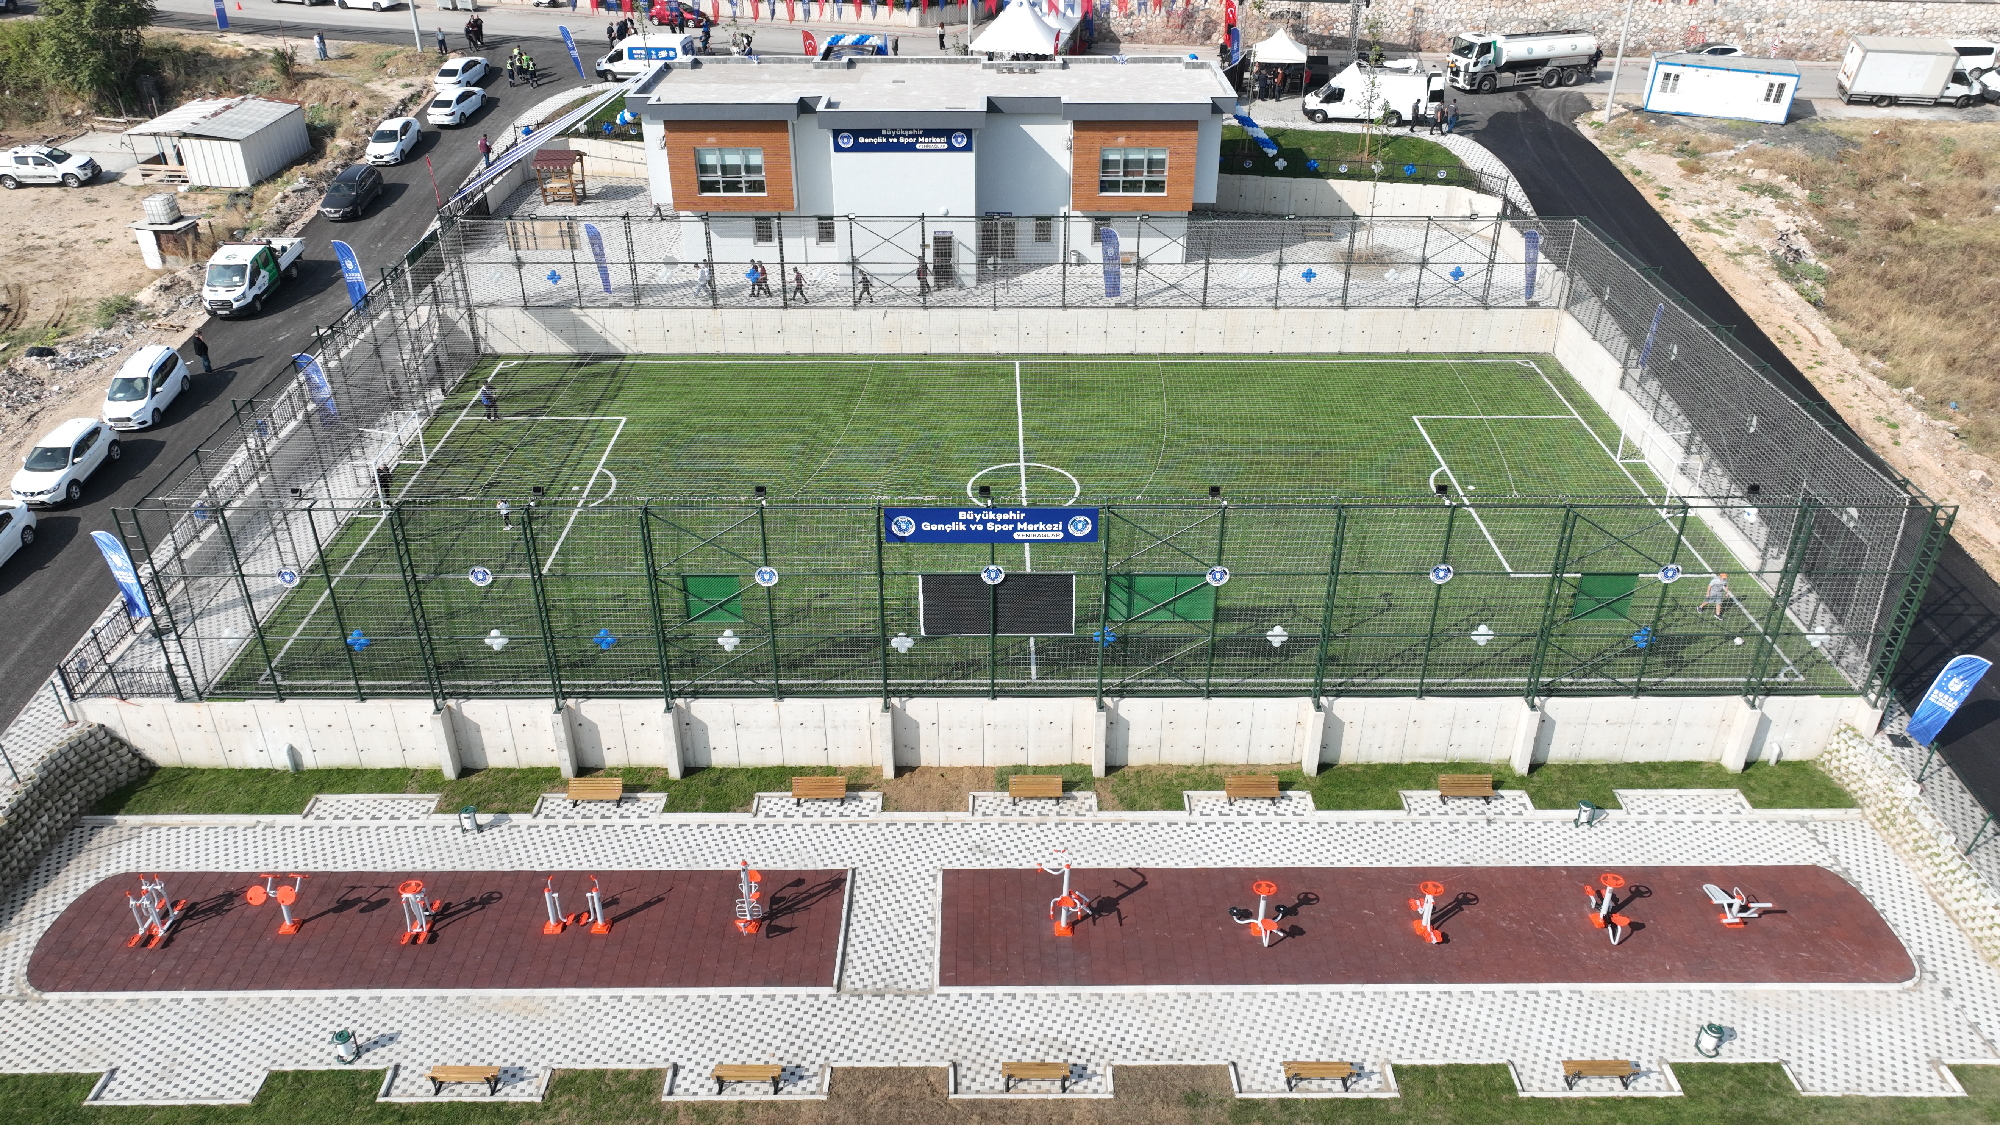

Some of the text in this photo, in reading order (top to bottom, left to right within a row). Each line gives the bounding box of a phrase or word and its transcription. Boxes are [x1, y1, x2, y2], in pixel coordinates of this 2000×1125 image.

[881, 129, 924, 137] Büyükşehir
[858, 136, 887, 145] Gençlik
[899, 136, 917, 145] Spor
[958, 511, 1026, 522] Büyükşehir
[921, 521, 1063, 533] Gençlik ve Spor Merkezi
